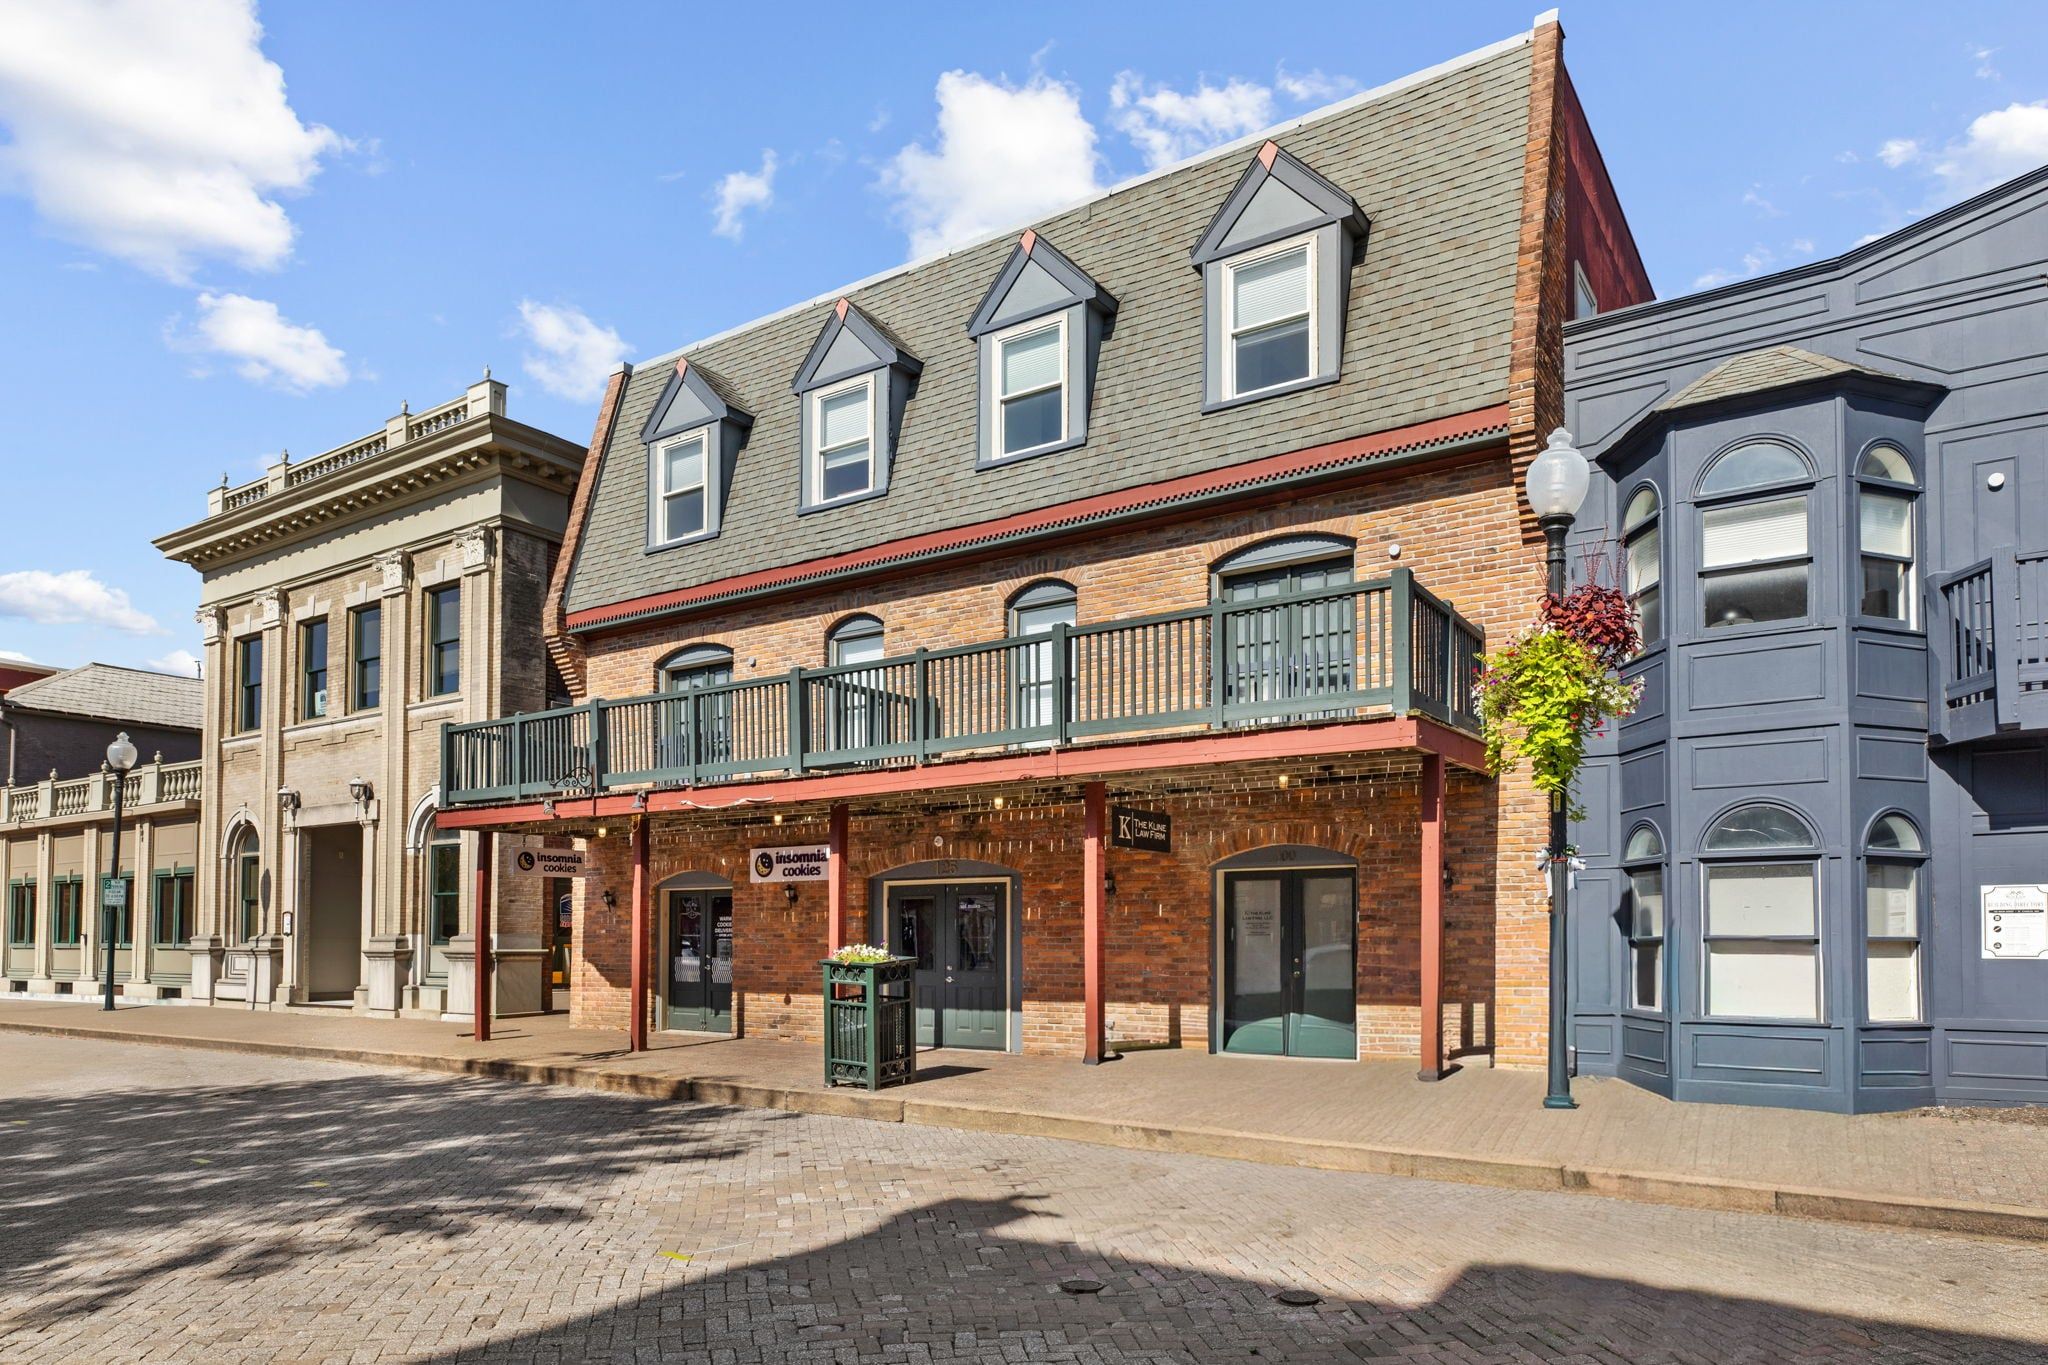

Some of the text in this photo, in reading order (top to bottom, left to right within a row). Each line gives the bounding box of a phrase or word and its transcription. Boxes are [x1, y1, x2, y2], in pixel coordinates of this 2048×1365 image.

[1118, 815, 1132, 840] K
[1133, 818, 1167, 832] THE KLINE
[1135, 829, 1166, 841] LAW FIRM
[537, 852, 582, 864] insomnia
[776, 850, 828, 864] insomnia
[543, 864, 577, 873] cookies
[782, 864, 821, 877] cookies
[105, 880, 111, 888] 2
